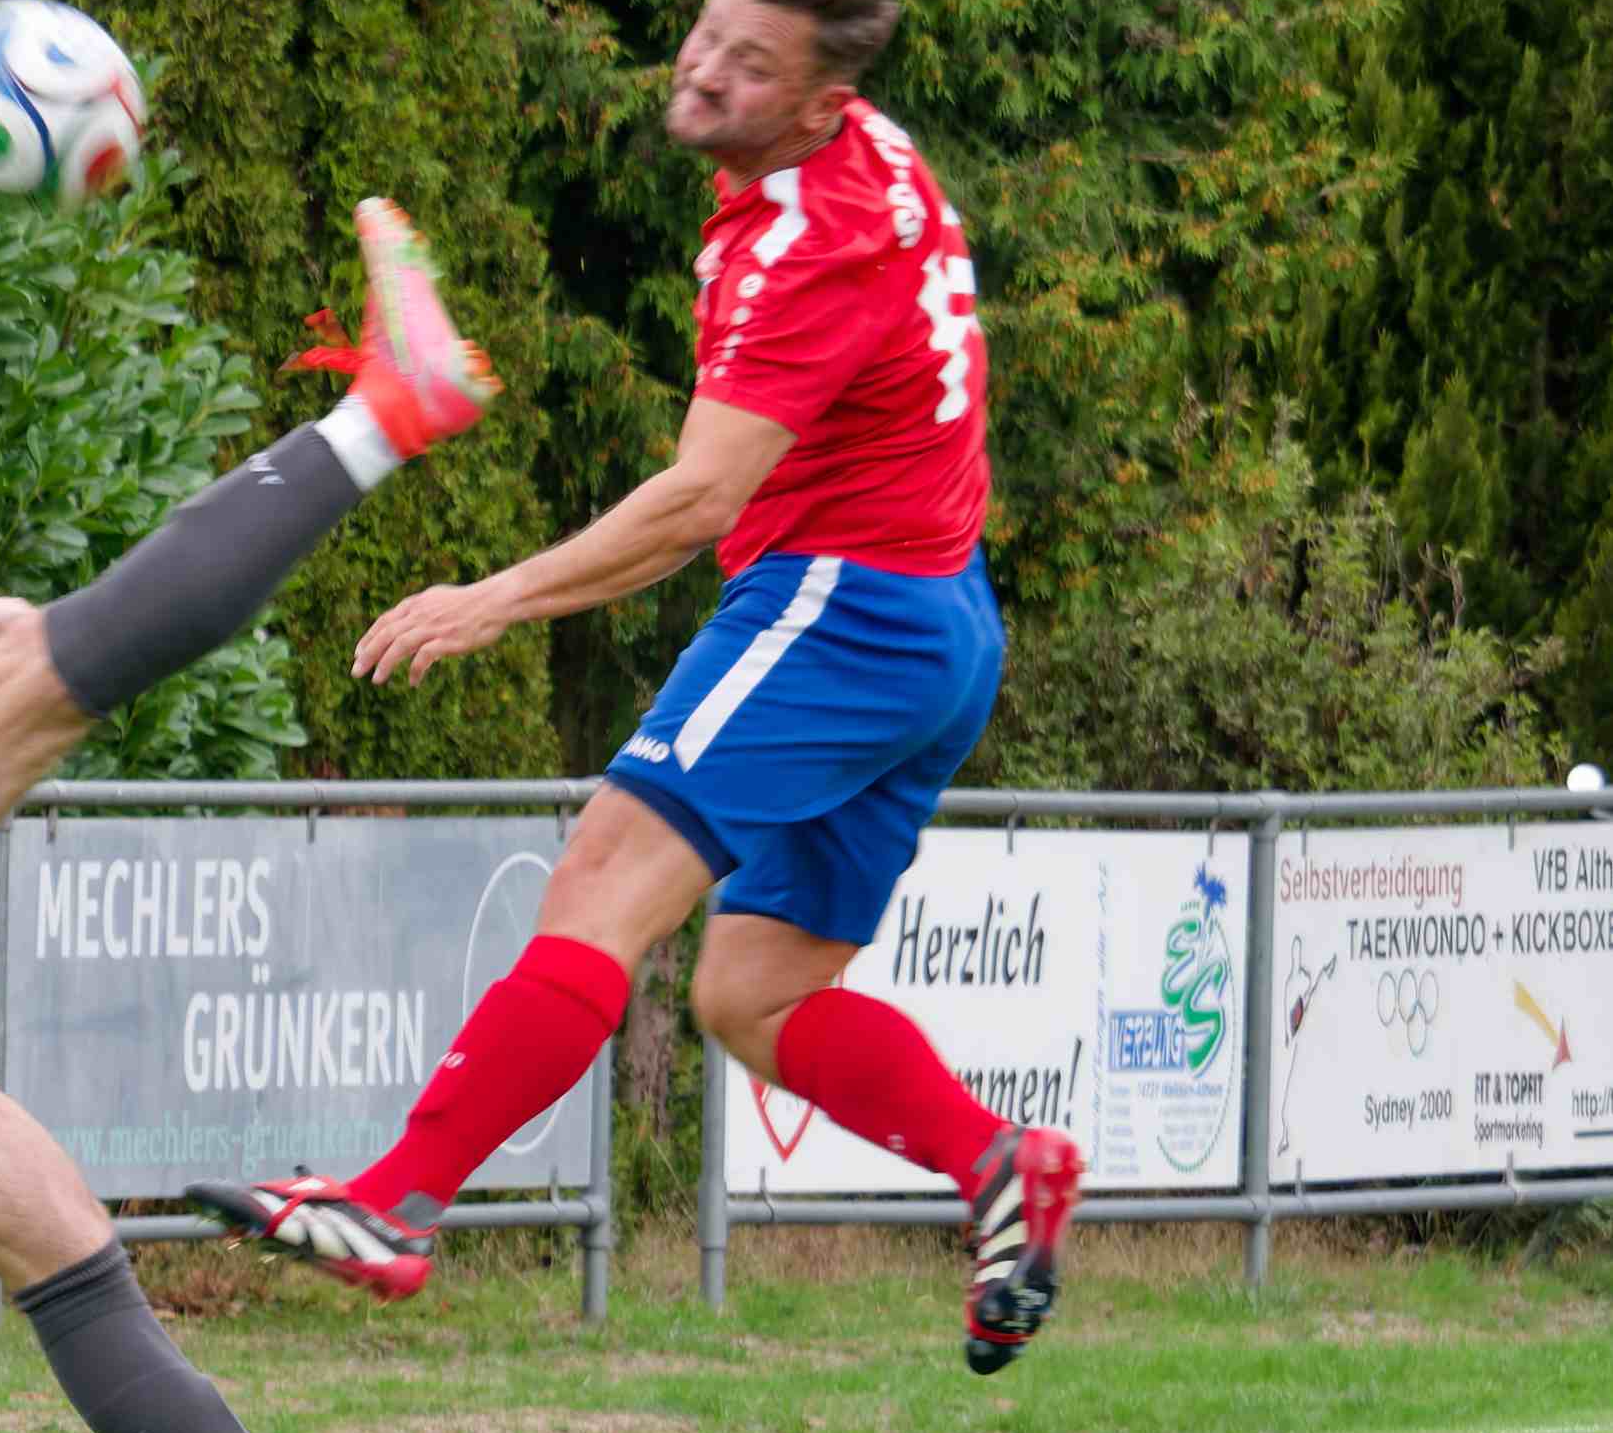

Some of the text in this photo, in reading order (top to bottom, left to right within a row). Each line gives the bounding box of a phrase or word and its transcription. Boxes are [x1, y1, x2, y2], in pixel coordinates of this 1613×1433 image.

[1279, 856, 1463, 911] Selbstverteidigung
[1533, 849, 1567, 892] VfB
[36, 859, 270, 959] MECHLERS
[893, 892, 1045, 986] Herzlich
[1347, 915, 1487, 961] TAEKWONDO
[1492, 927, 1504, 948] +
[183, 962, 425, 1093] GRÜNKERN
[1111, 1013, 1184, 1070] WERBUNG
[1364, 1090, 1452, 1131] Sydney 2000
[1474, 1071, 1543, 1105] FIT & TOPFIT
[1473, 1111, 1544, 1150] Sportmarketing
